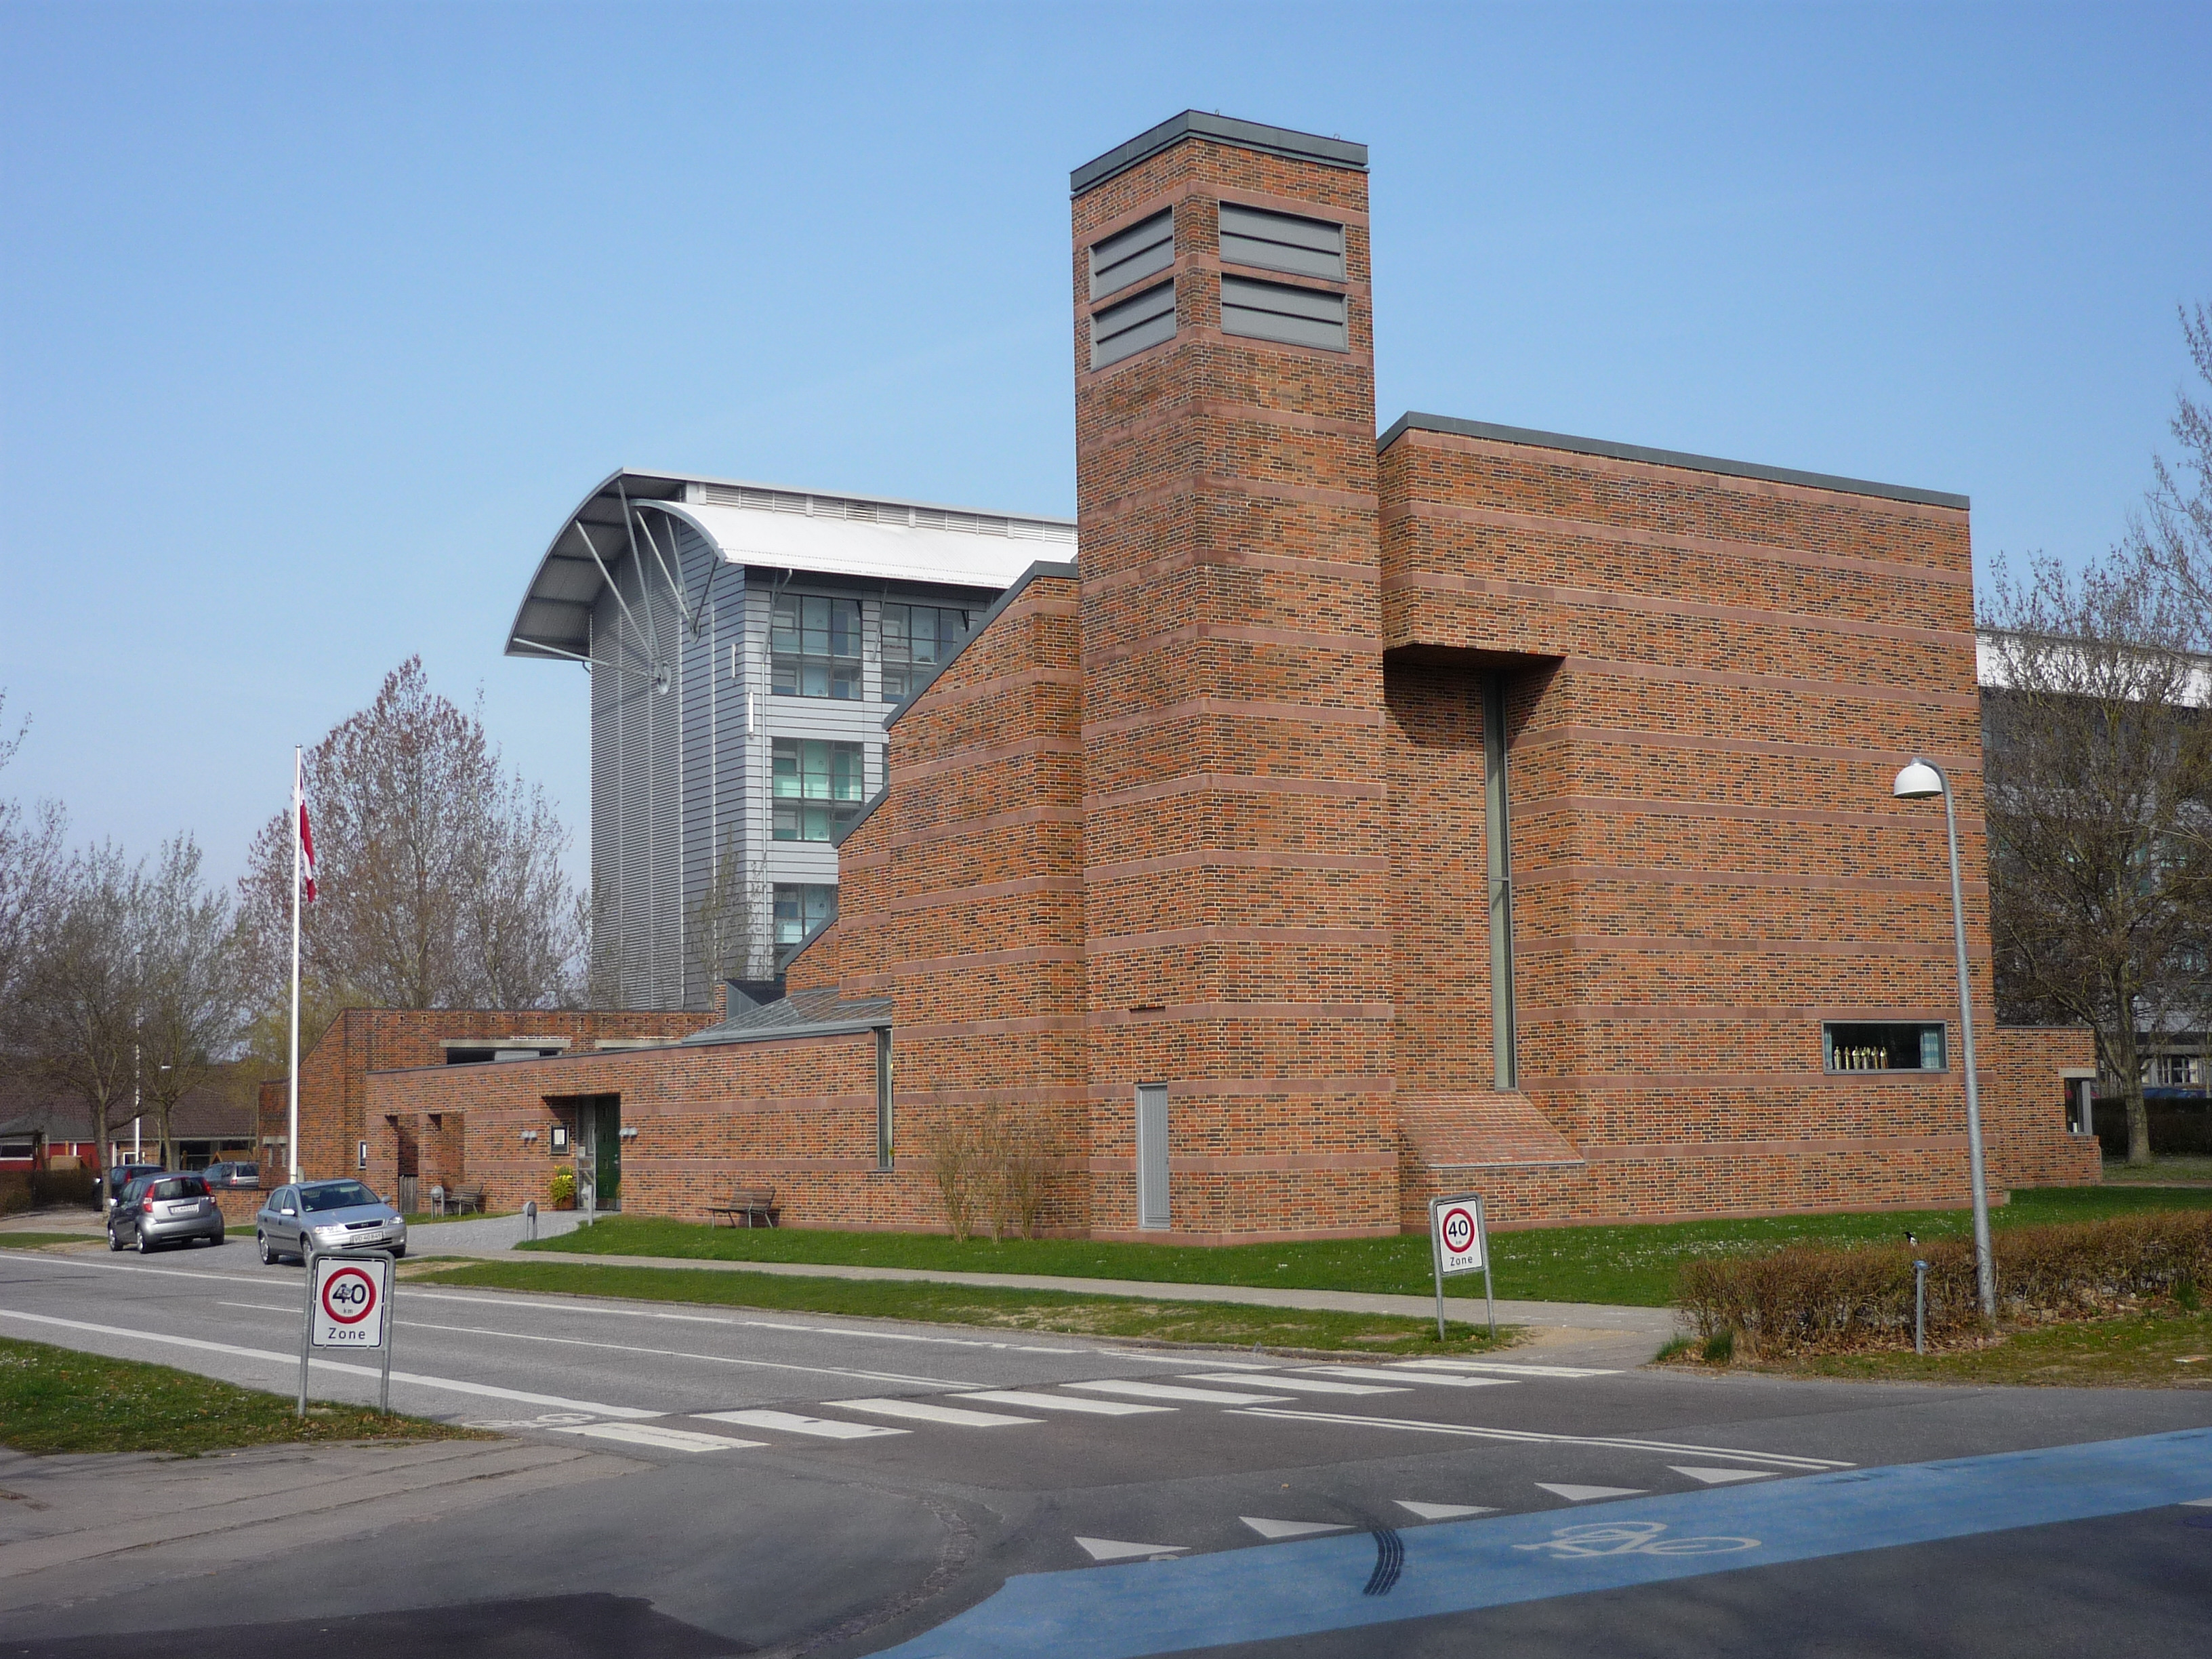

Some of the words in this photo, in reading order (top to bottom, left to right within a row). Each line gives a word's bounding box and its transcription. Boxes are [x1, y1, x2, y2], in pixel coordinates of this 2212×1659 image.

[1448, 1220, 1469, 1237] 40
[1450, 1256, 1473, 1267] Zone
[332, 1283, 367, 1305] 40
[328, 1327, 366, 1340] Zone
